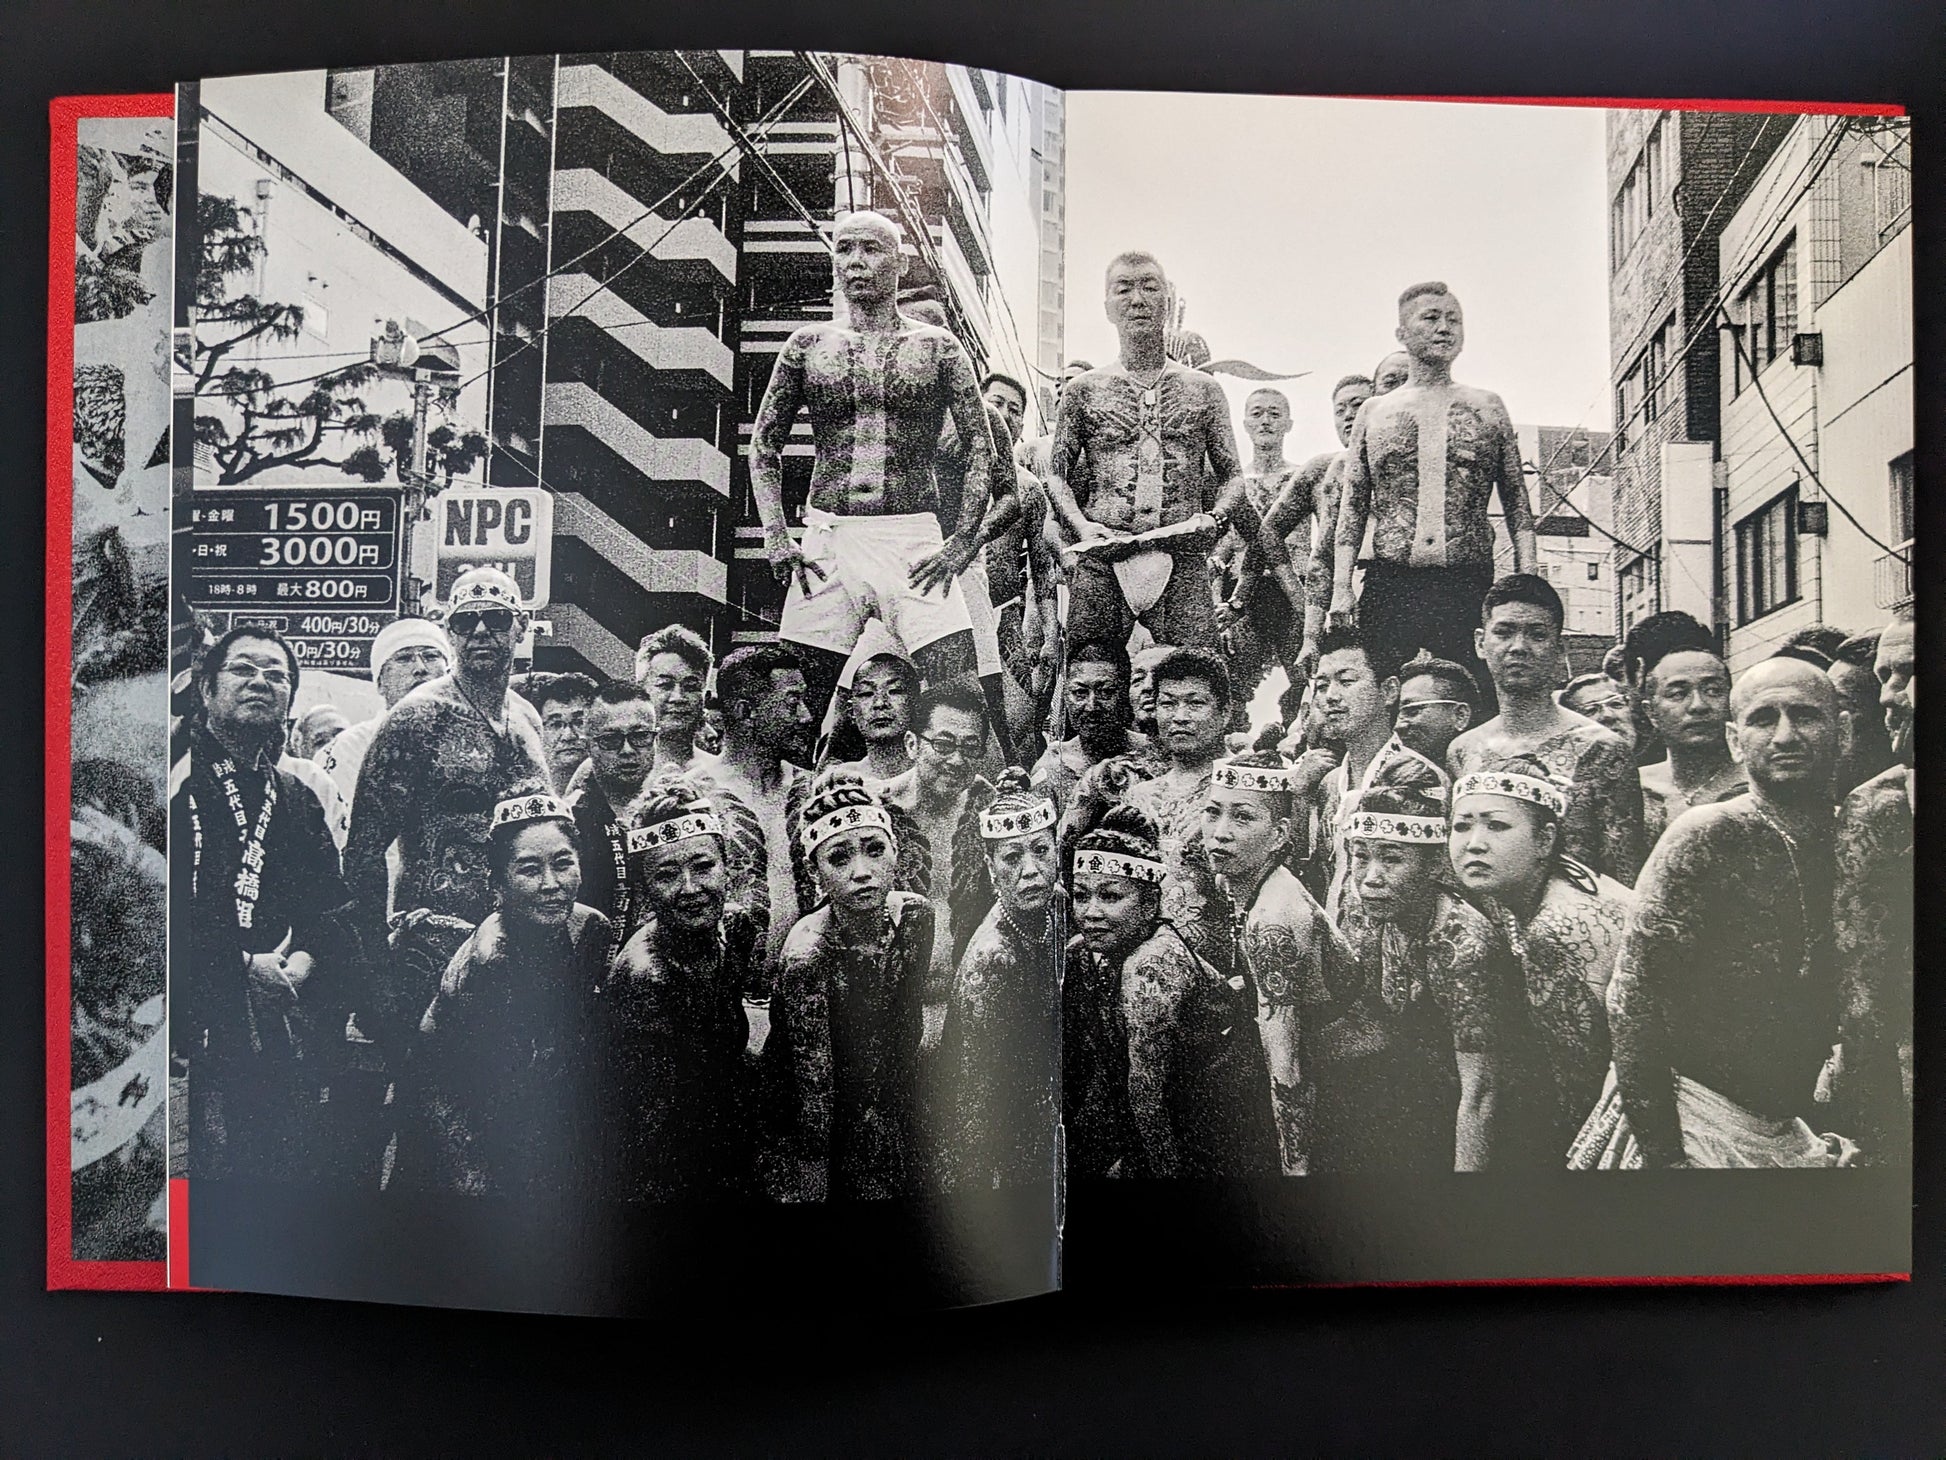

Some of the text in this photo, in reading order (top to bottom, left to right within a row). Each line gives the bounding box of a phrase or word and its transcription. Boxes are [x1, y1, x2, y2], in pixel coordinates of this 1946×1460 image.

[263, 501, 381, 532] 1500円
[445, 498, 532, 547] NPC
[259, 537, 379, 566] 3000円
[301, 616, 381, 634] 400円/30分
